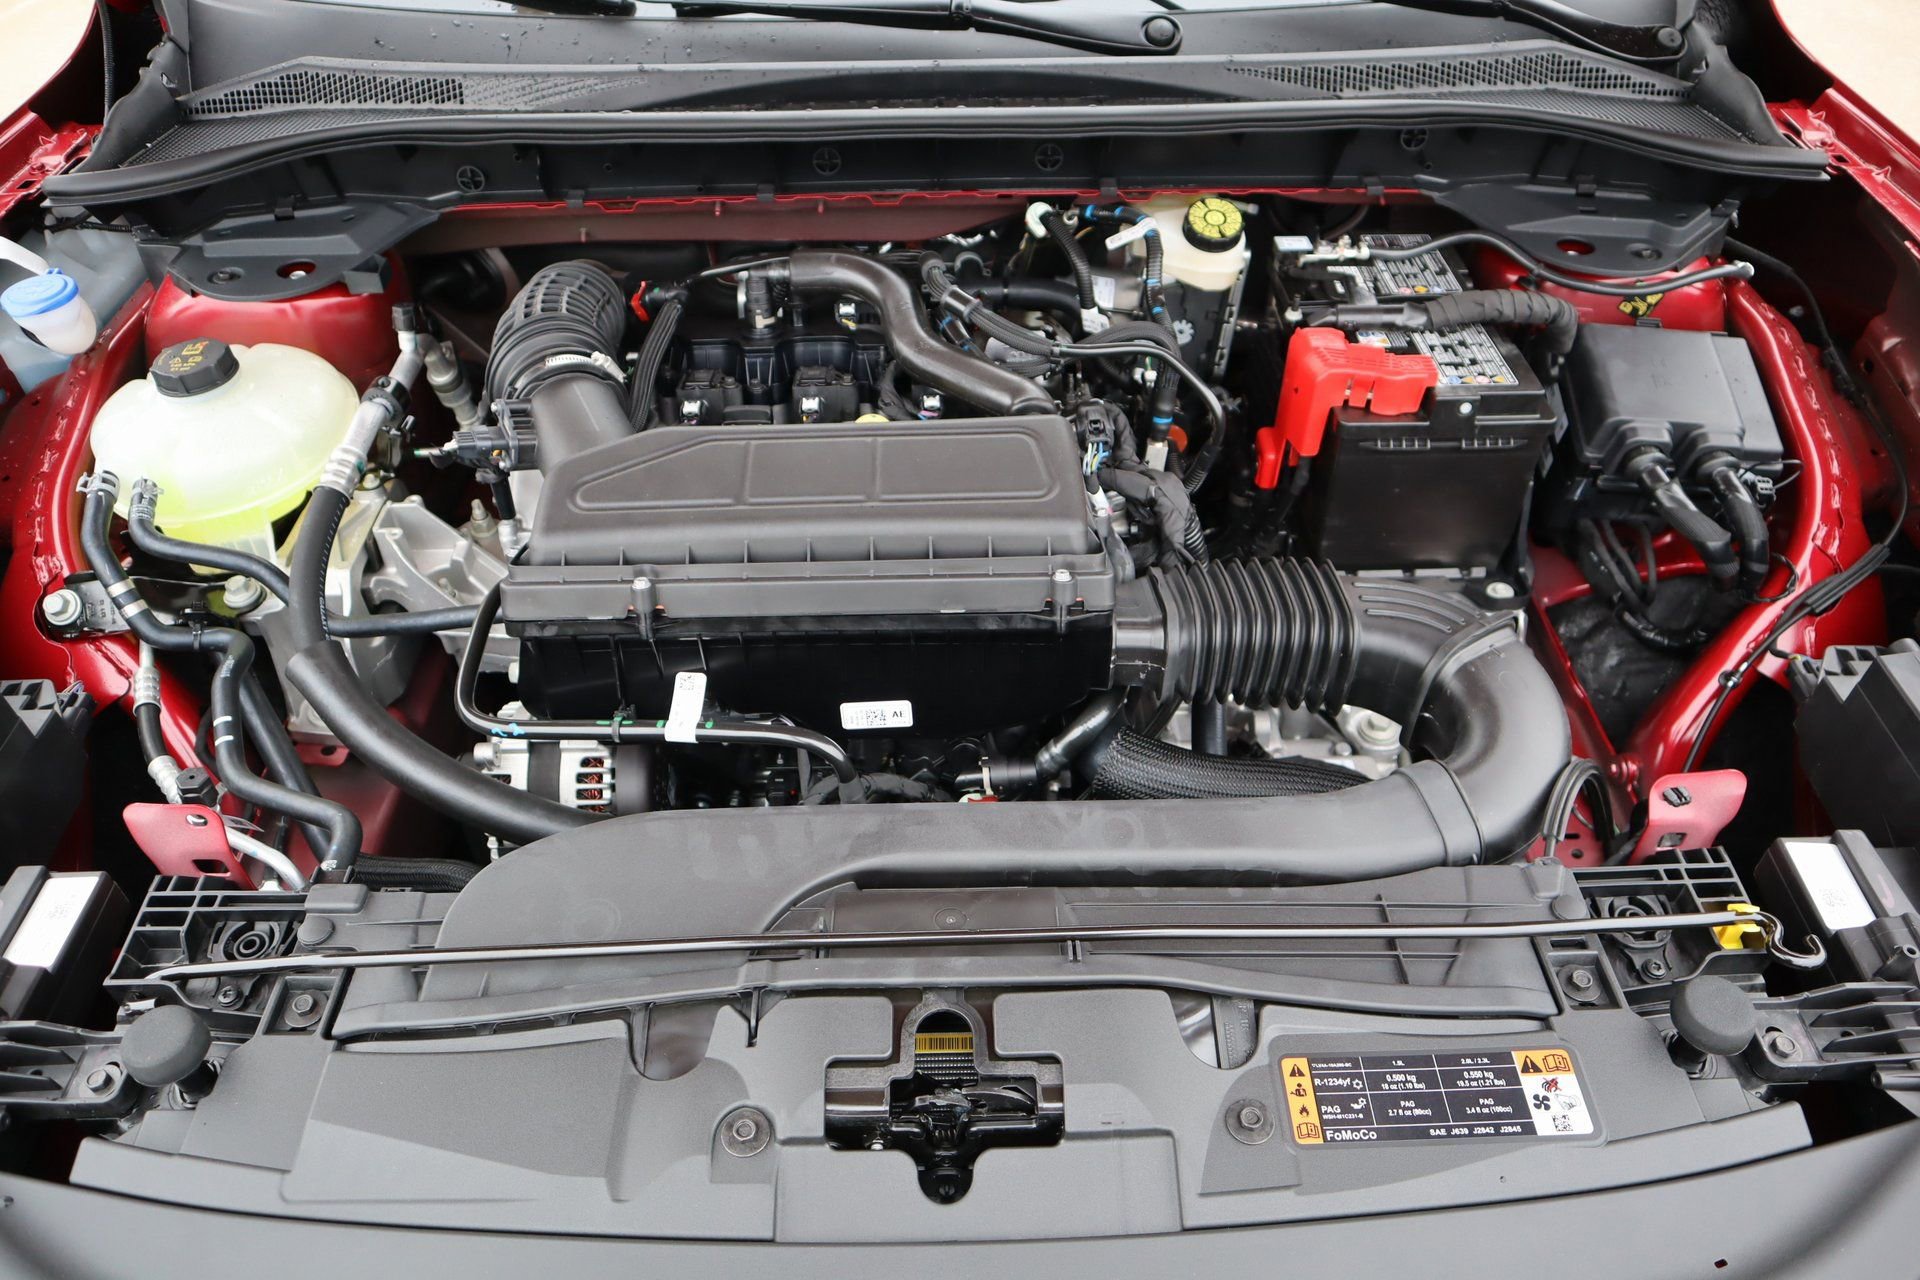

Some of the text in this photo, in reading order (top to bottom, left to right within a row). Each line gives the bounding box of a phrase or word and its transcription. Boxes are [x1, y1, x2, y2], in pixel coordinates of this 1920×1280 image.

[1386, 1074, 1417, 1082] 0.500 kg
[1464, 1070, 1494, 1079] 0.550 kg
[1314, 1078, 1351, 1087] R-1234yf
[1478, 1079, 1493, 1087] (1.21
[1400, 1100, 1415, 1108] PAG
[1321, 1105, 1341, 1114] PAG
[1326, 1129, 1377, 1141] FoMoCo
[1429, 1128, 1447, 1136] SAE
